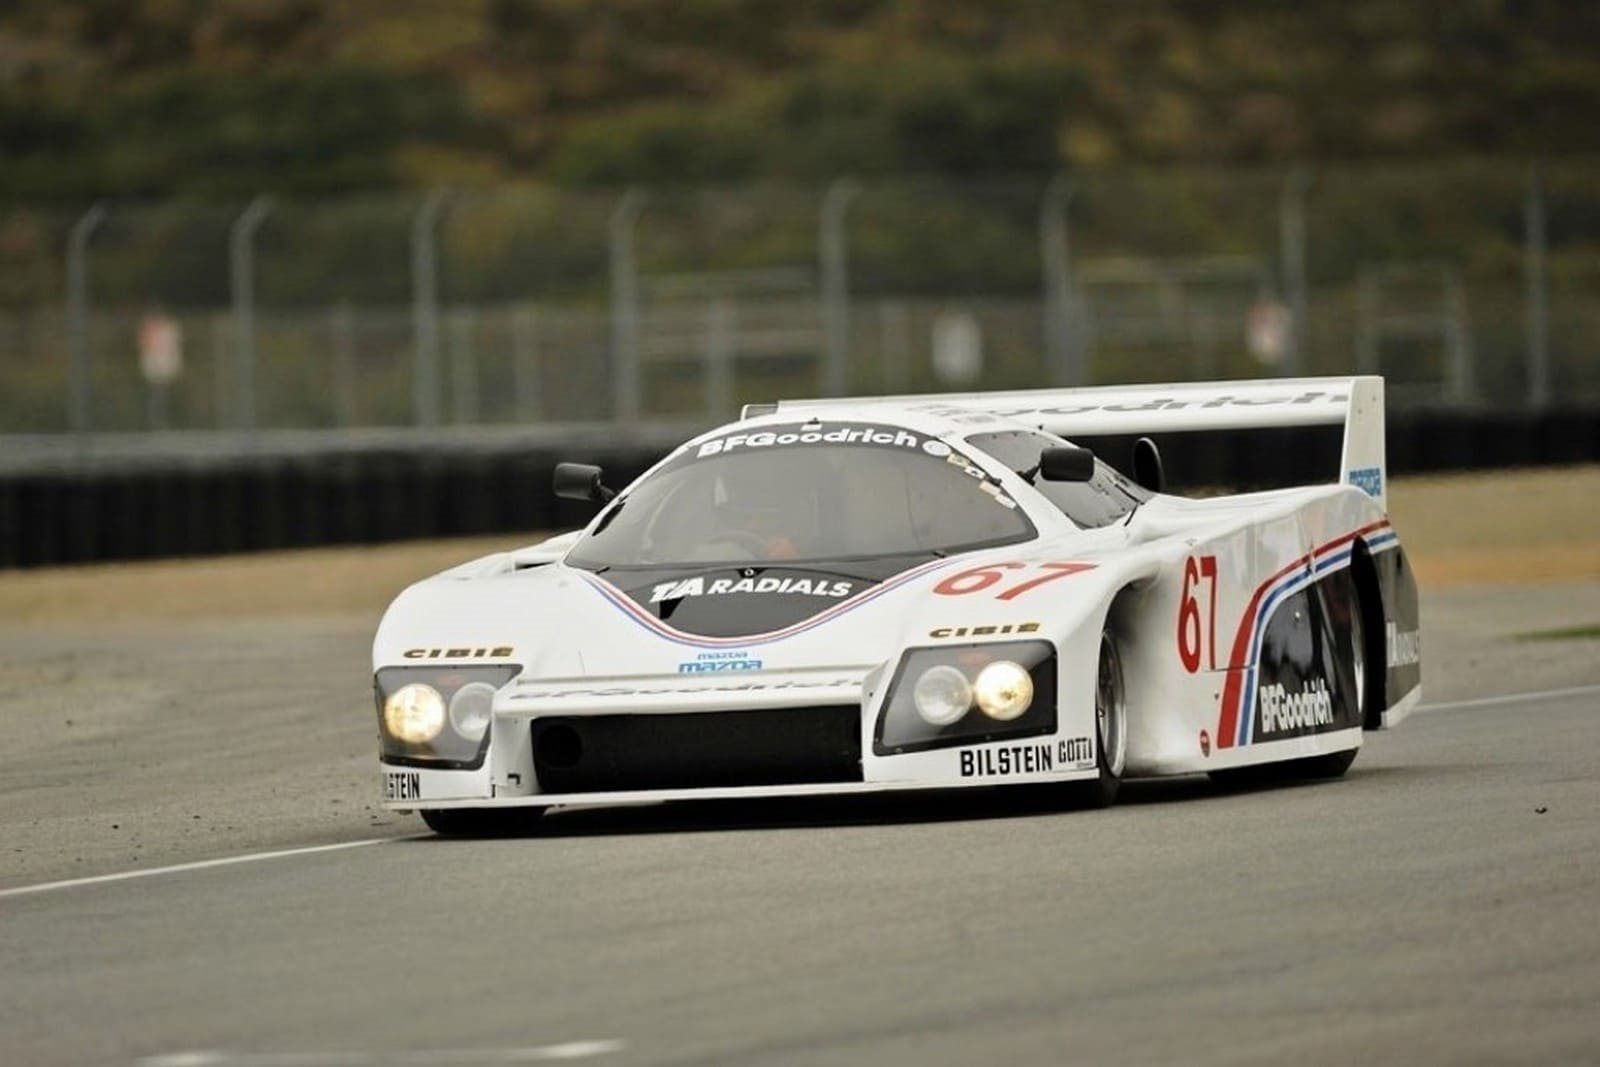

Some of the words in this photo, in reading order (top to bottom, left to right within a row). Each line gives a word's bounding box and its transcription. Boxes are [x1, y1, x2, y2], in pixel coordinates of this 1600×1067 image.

[697, 427, 919, 459] BFGoodrich
[706, 578, 854, 597] RADIALS
[931, 560, 1098, 601] 67
[1177, 555, 1218, 674] 67
[678, 660, 763, 673] mazda
[1260, 676, 1334, 734] BFGoodrich
[960, 744, 1053, 778] BILSTEIN
[1058, 737, 1093, 764] GOTTI
